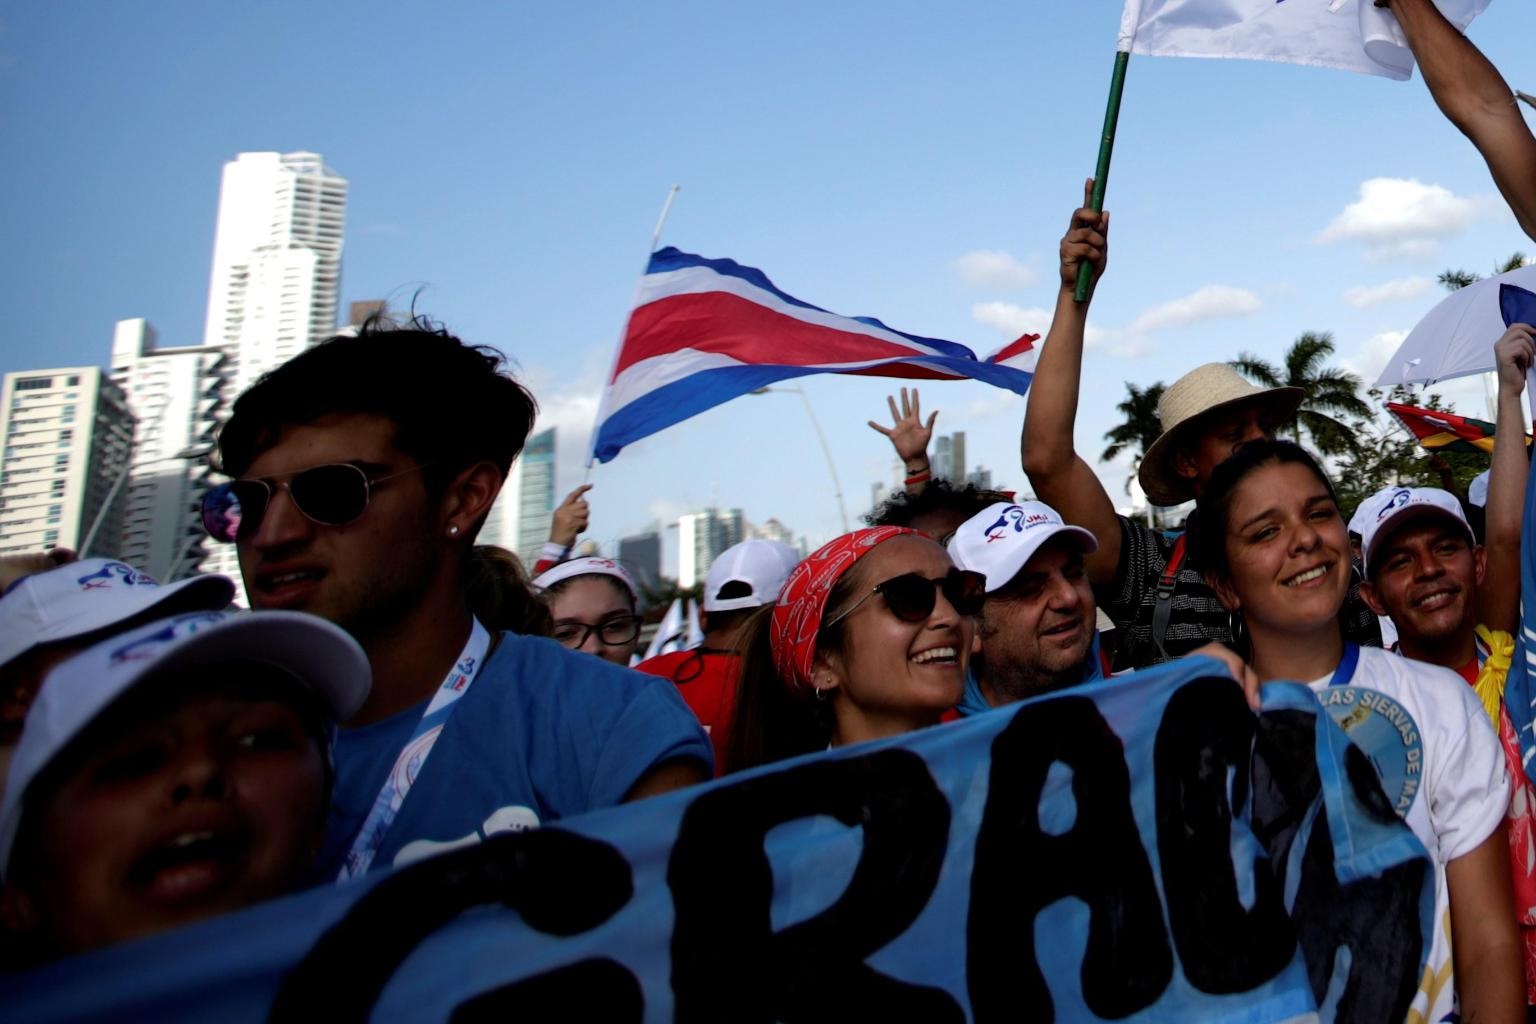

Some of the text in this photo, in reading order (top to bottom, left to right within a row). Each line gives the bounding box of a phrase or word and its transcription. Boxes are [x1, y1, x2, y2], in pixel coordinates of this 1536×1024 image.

[1316, 689, 1355, 707] LAS
[1360, 691, 1418, 746] SIERVAS
[1406, 747, 1420, 775] DE
